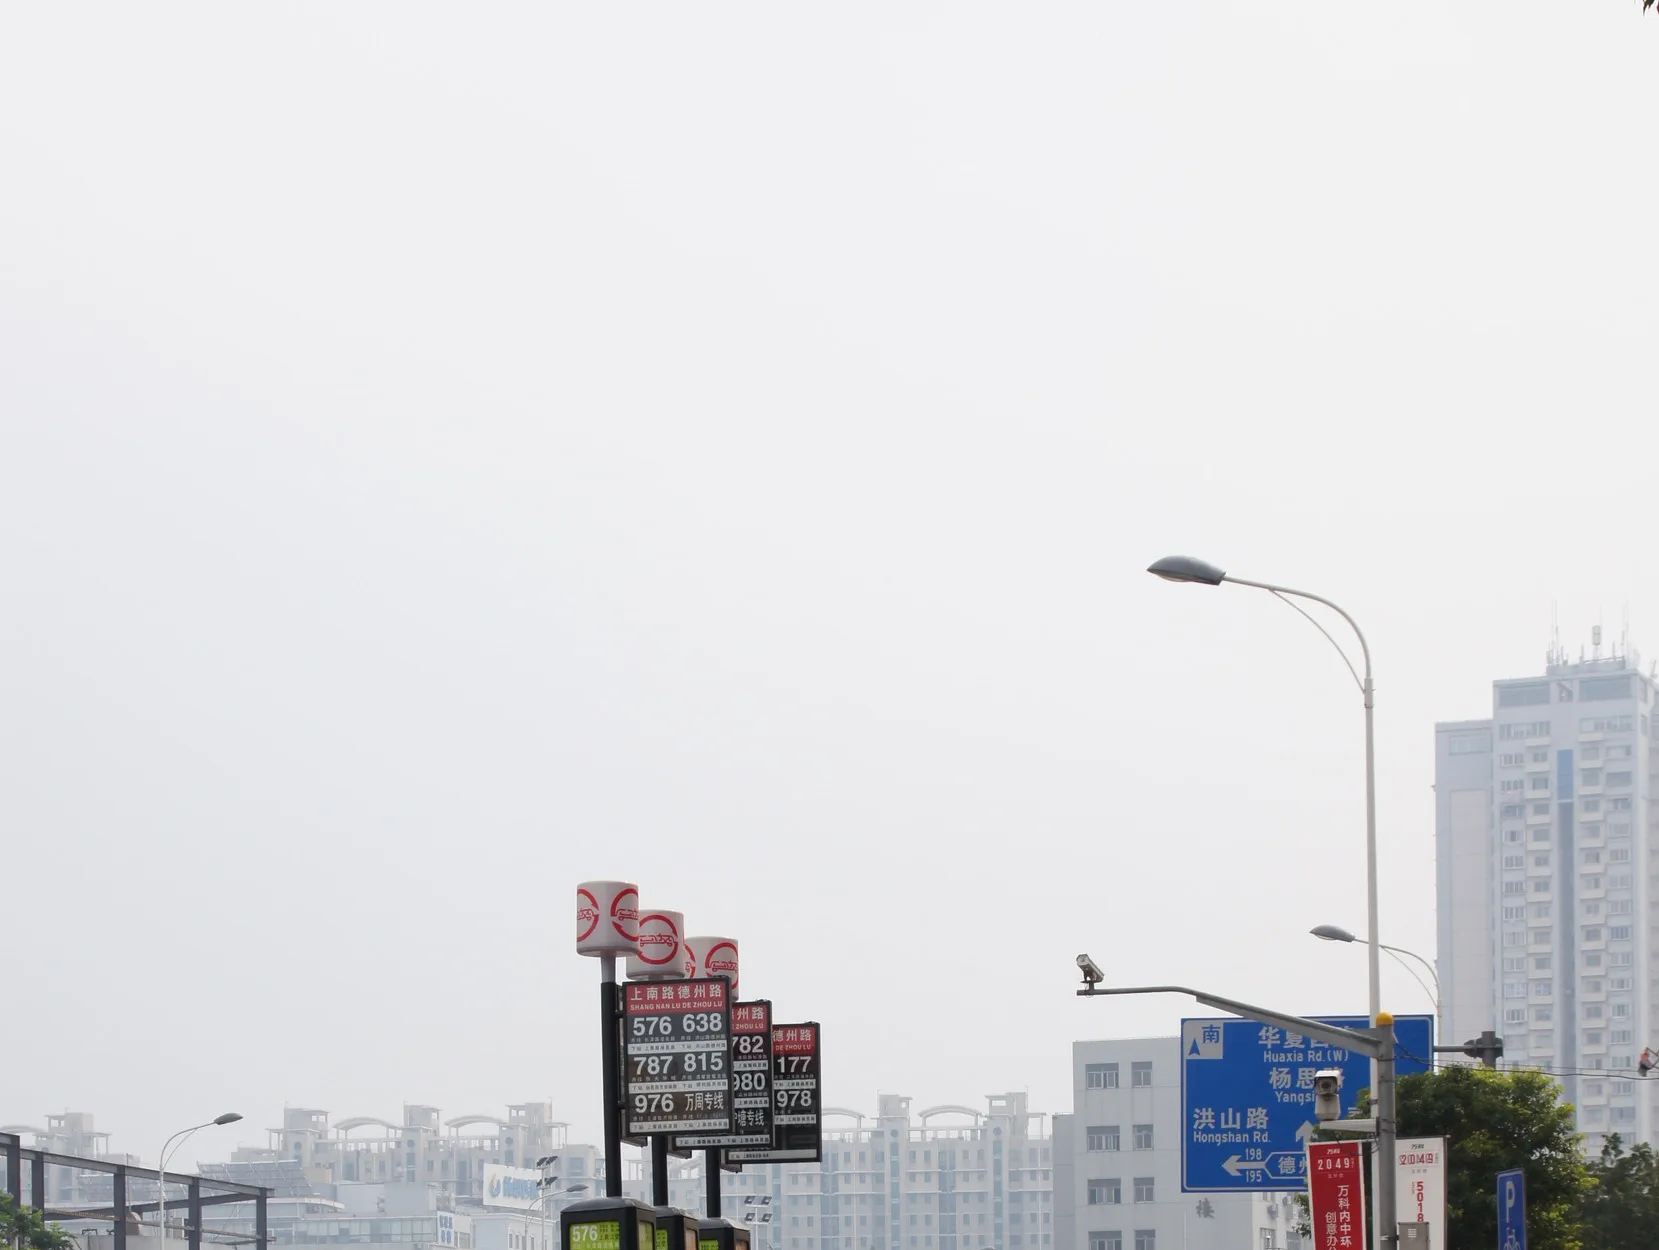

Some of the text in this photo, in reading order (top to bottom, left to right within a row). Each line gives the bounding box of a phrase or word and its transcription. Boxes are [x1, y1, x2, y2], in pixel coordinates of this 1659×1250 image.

[631, 984, 722, 1001] 上南路德州路
[630, 1003, 654, 1011] SHANG
[732, 1007, 764, 1020] 州路
[633, 1013, 722, 1036] 576 638
[772, 1029, 811, 1042] 德州路
[1201, 1024, 1221, 1044] 南
[1258, 1026, 1354, 1049] 华夏
[634, 1052, 723, 1075] 787 815
[777, 1056, 811, 1073] 177
[1263, 1050, 1303, 1063] Huaxia
[733, 1073, 766, 1091] 980
[635, 1093, 674, 1113] 976
[685, 1092, 724, 1111] 万周专线
[776, 1090, 812, 1107] 978
[1275, 1091, 1317, 1106] Yangsi
[1193, 1107, 1269, 1130] 洪山路
[1193, 1131, 1271, 1146] Hongshan Rd.
[1245, 1148, 1262, 1160] 198
[1317, 1157, 1350, 1170] 2049
[1245, 1170, 1262, 1183] 195
[1506, 1180, 1515, 1223] P
[1337, 1184, 1352, 1248] 万科内中环
[572, 1223, 598, 1242] 576
